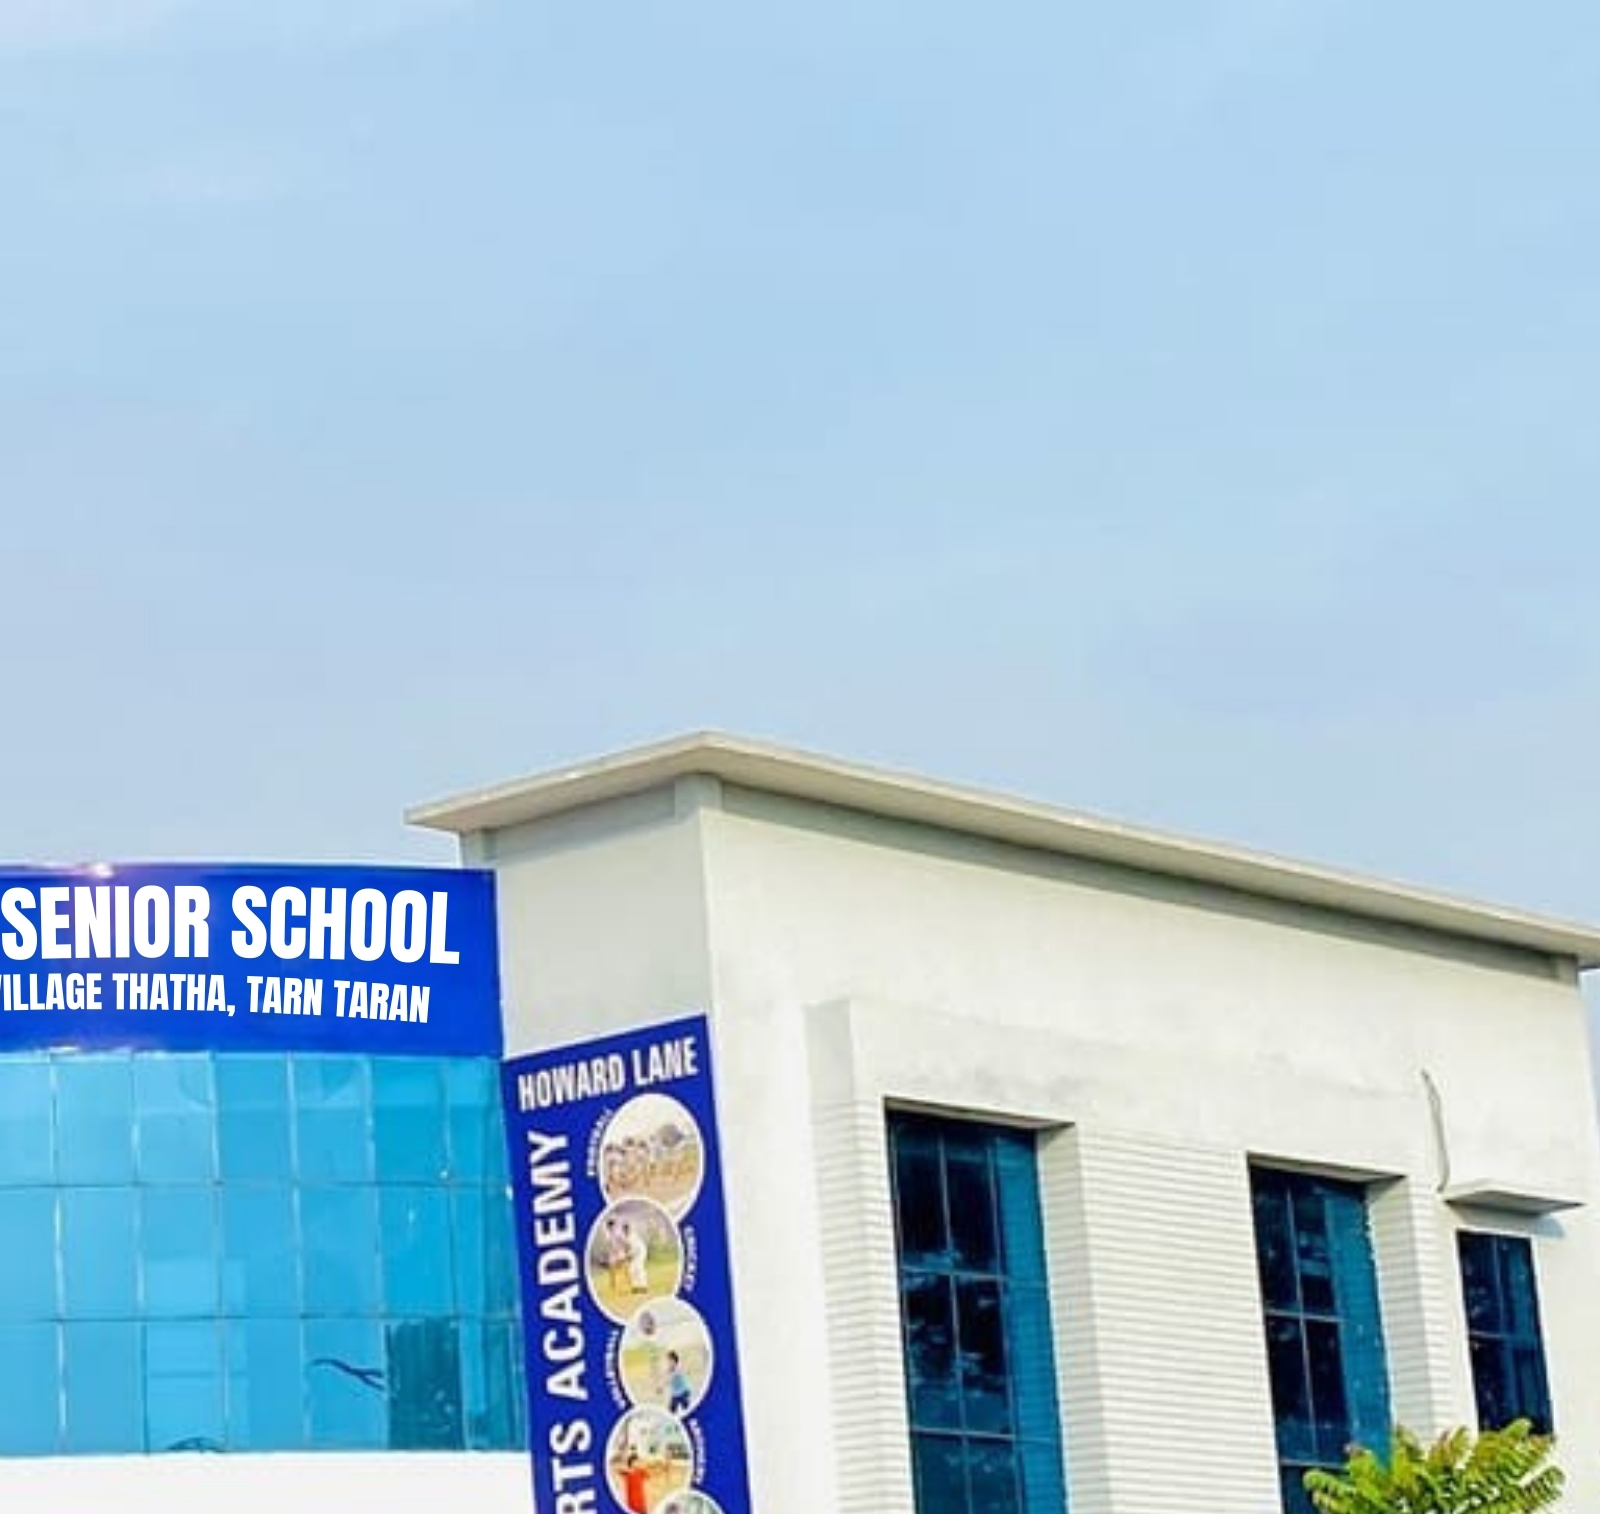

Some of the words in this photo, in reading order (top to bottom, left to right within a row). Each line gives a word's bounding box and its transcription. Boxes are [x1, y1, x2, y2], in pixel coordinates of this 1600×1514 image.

[2, 885, 209, 960] SENIOR
[232, 886, 460, 965] SCHOOL
[113, 974, 236, 1017] THATHA,
[246, 976, 323, 1016] TARN
[333, 981, 430, 1023] TARAN
[518, 1054, 626, 1112] HOWARD
[632, 1036, 698, 1087] LANE
[527, 1130, 588, 1401] ACADEMY
